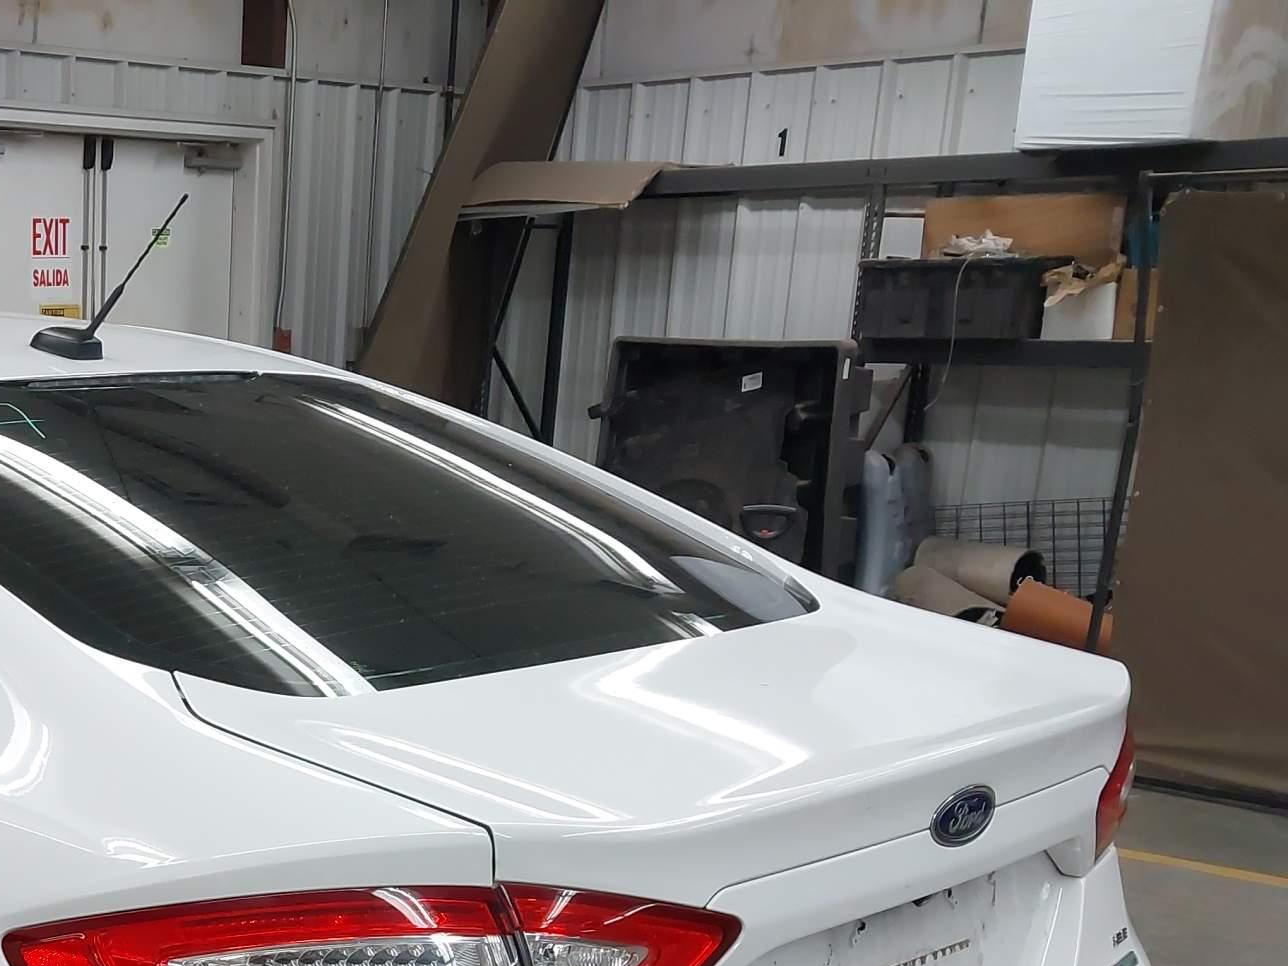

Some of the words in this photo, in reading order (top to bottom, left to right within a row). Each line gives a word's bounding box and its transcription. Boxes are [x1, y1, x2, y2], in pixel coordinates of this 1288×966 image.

[778, 128, 788, 156] 1
[32, 218, 70, 255] EXIT
[32, 269, 69, 287] SALIDA
[949, 800, 987, 834] Ford
